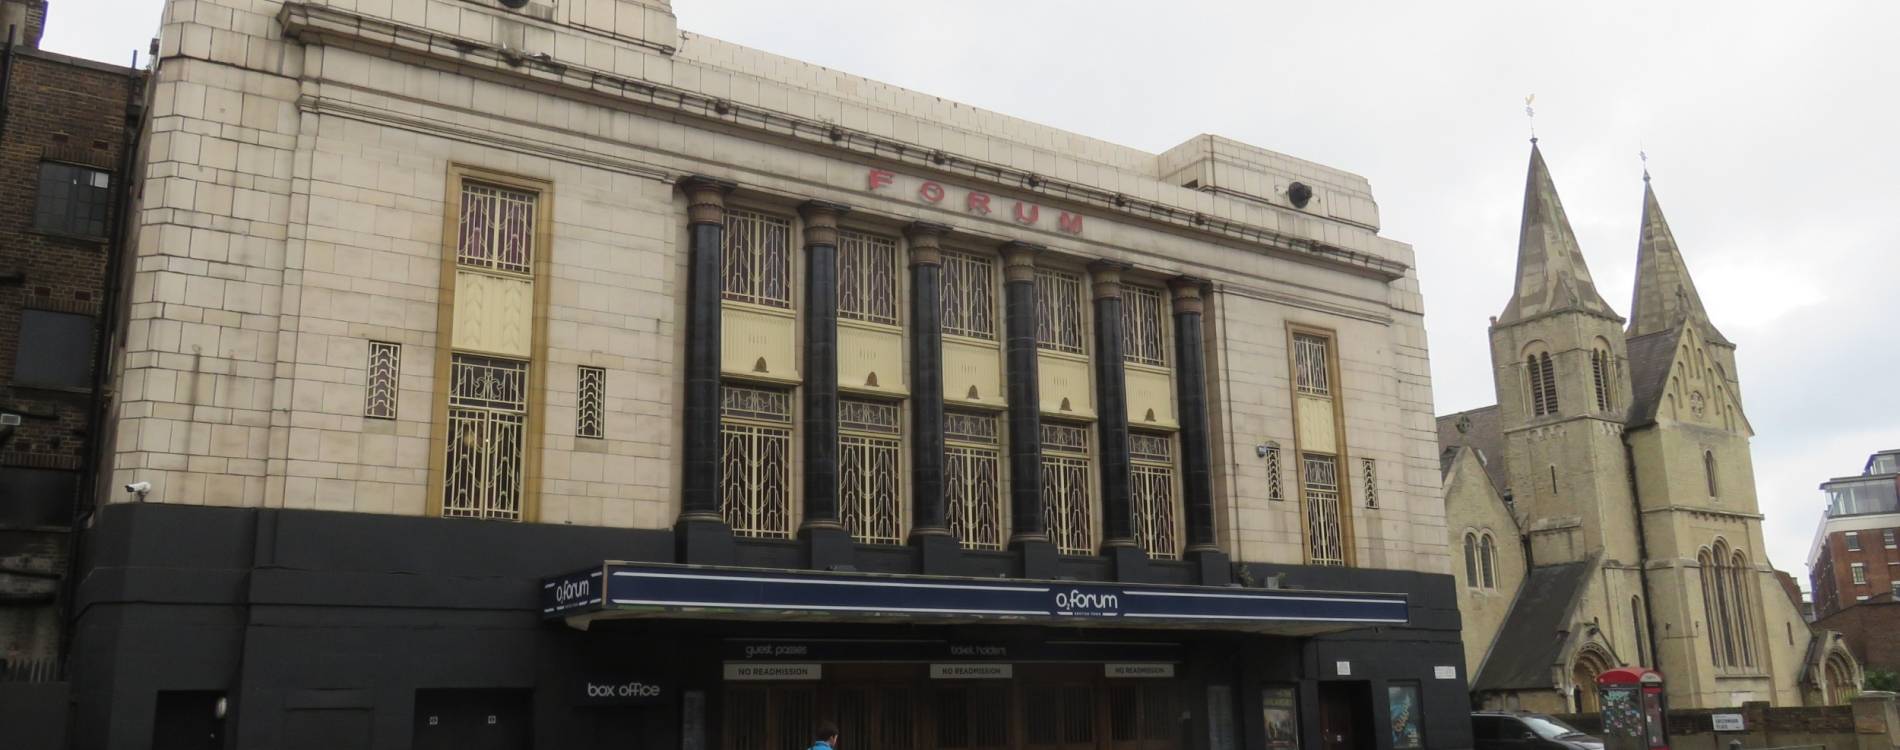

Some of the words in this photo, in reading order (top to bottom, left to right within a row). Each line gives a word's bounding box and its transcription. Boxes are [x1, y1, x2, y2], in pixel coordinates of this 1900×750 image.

[869, 169, 1083, 233] FORUM
[744, 643, 773, 659] guest
[775, 644, 808, 657] passes
[738, 667, 752, 676] NO
[753, 667, 809, 676] READMISSION
[942, 667, 953, 675] NO
[587, 682, 616, 697] box
[618, 682, 661, 697] office
